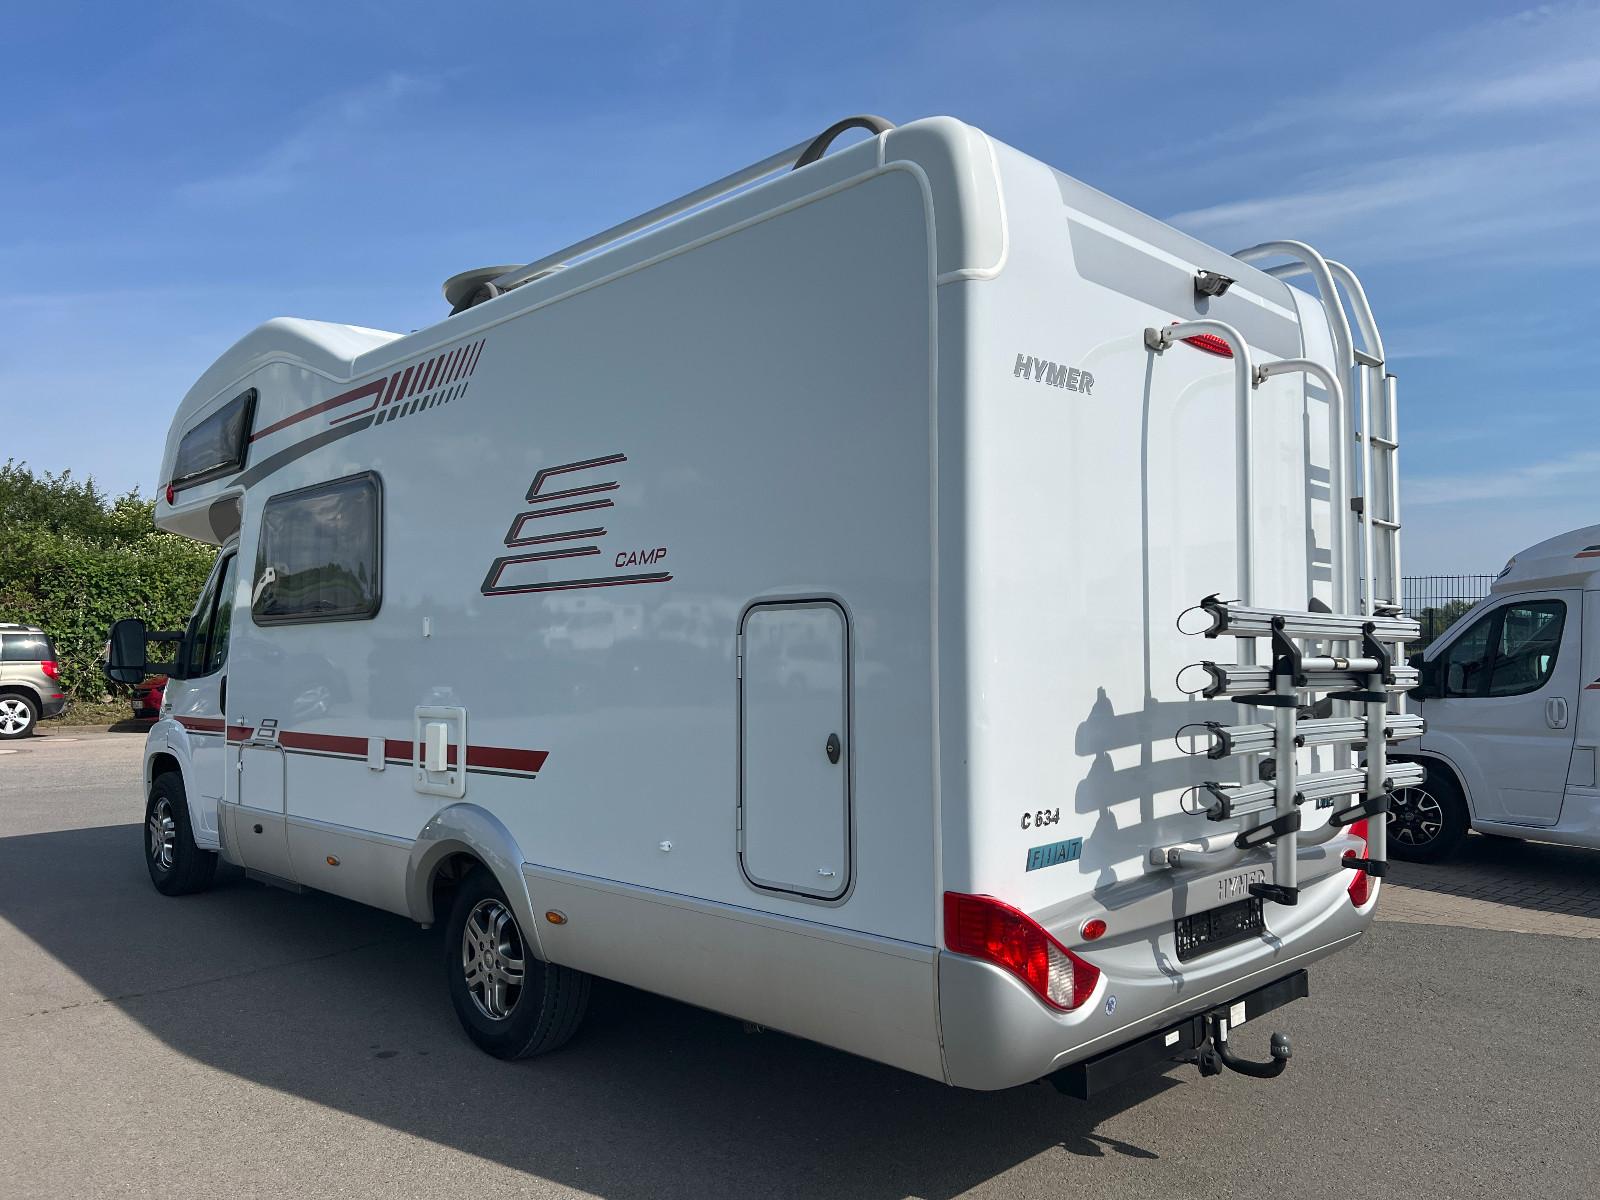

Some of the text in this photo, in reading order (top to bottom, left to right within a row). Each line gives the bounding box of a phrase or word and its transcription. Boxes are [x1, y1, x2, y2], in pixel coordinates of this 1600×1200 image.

[1013, 353, 1094, 395] HYMER
[615, 547, 667, 568] CAMP
[1021, 808, 1060, 830] C 634
[1030, 840, 1081, 869] FIAT
